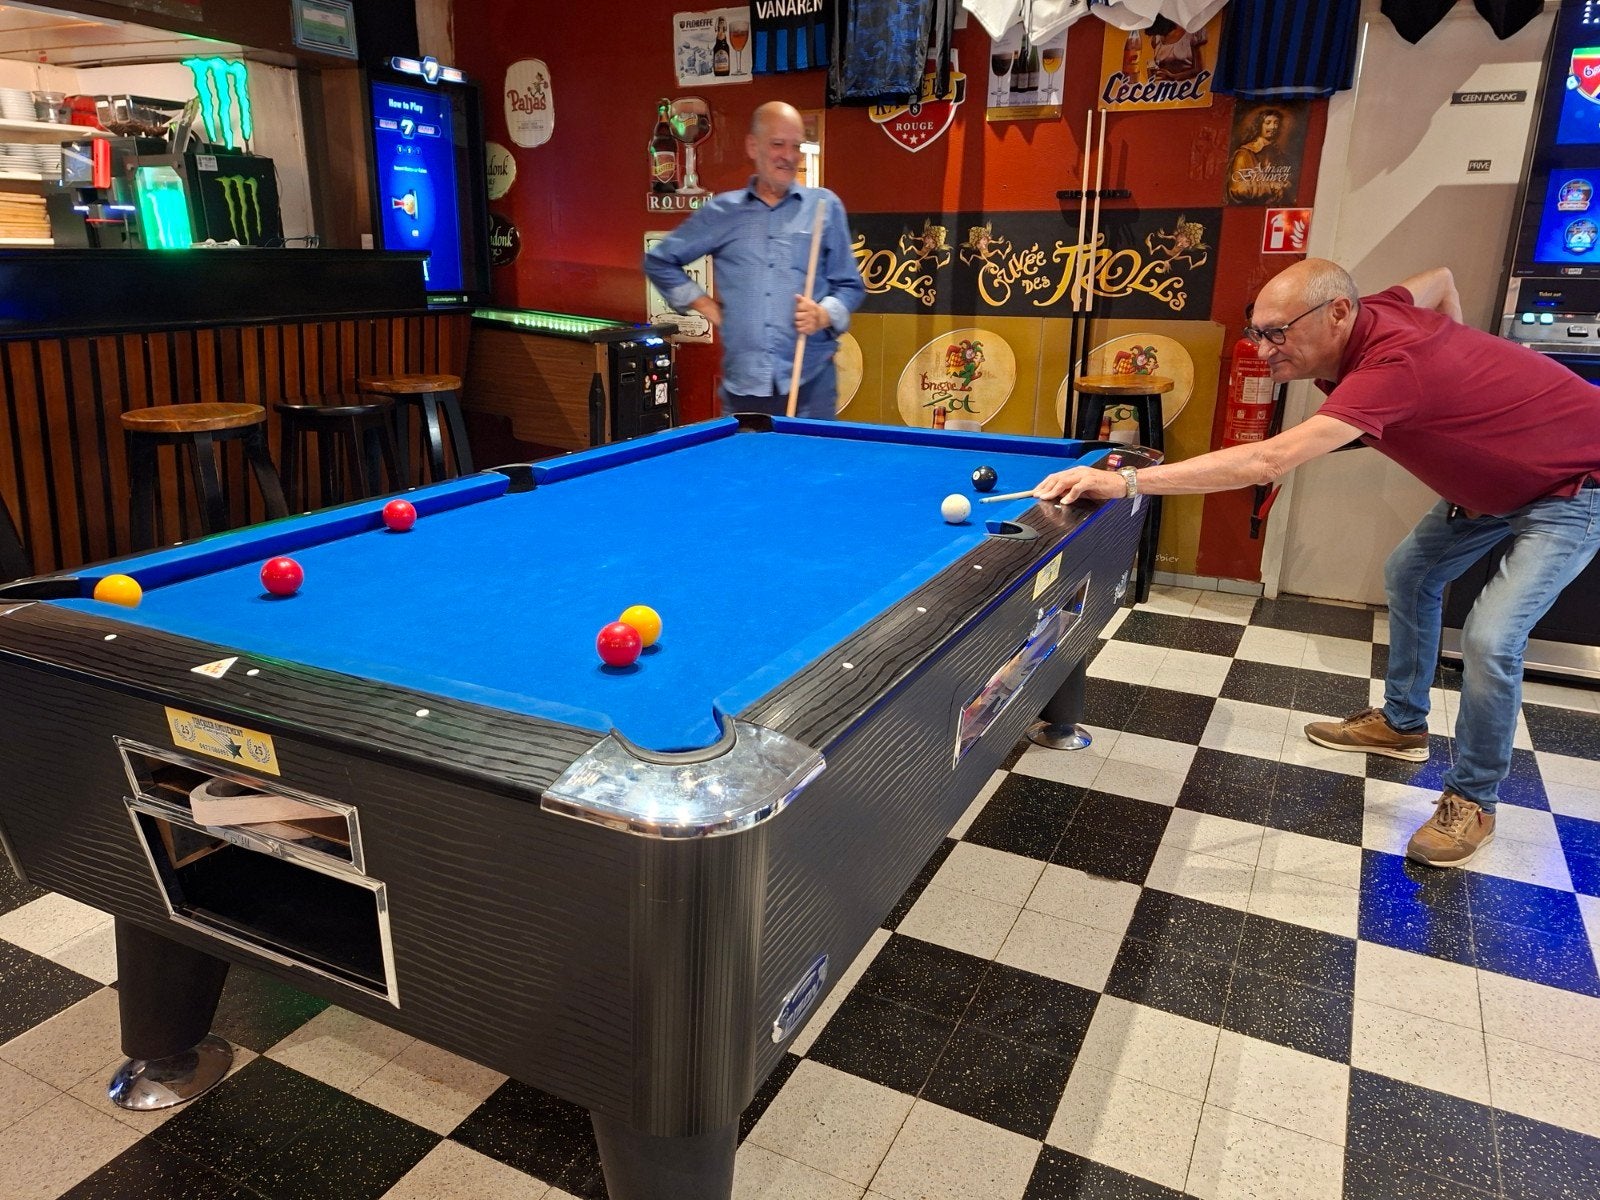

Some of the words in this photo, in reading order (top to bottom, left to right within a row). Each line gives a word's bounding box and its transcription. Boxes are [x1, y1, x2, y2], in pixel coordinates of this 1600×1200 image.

[1461, 94, 1481, 102] GEEN
[1483, 93, 1517, 101] INGANG
[896, 122, 933, 131] ROUGE
